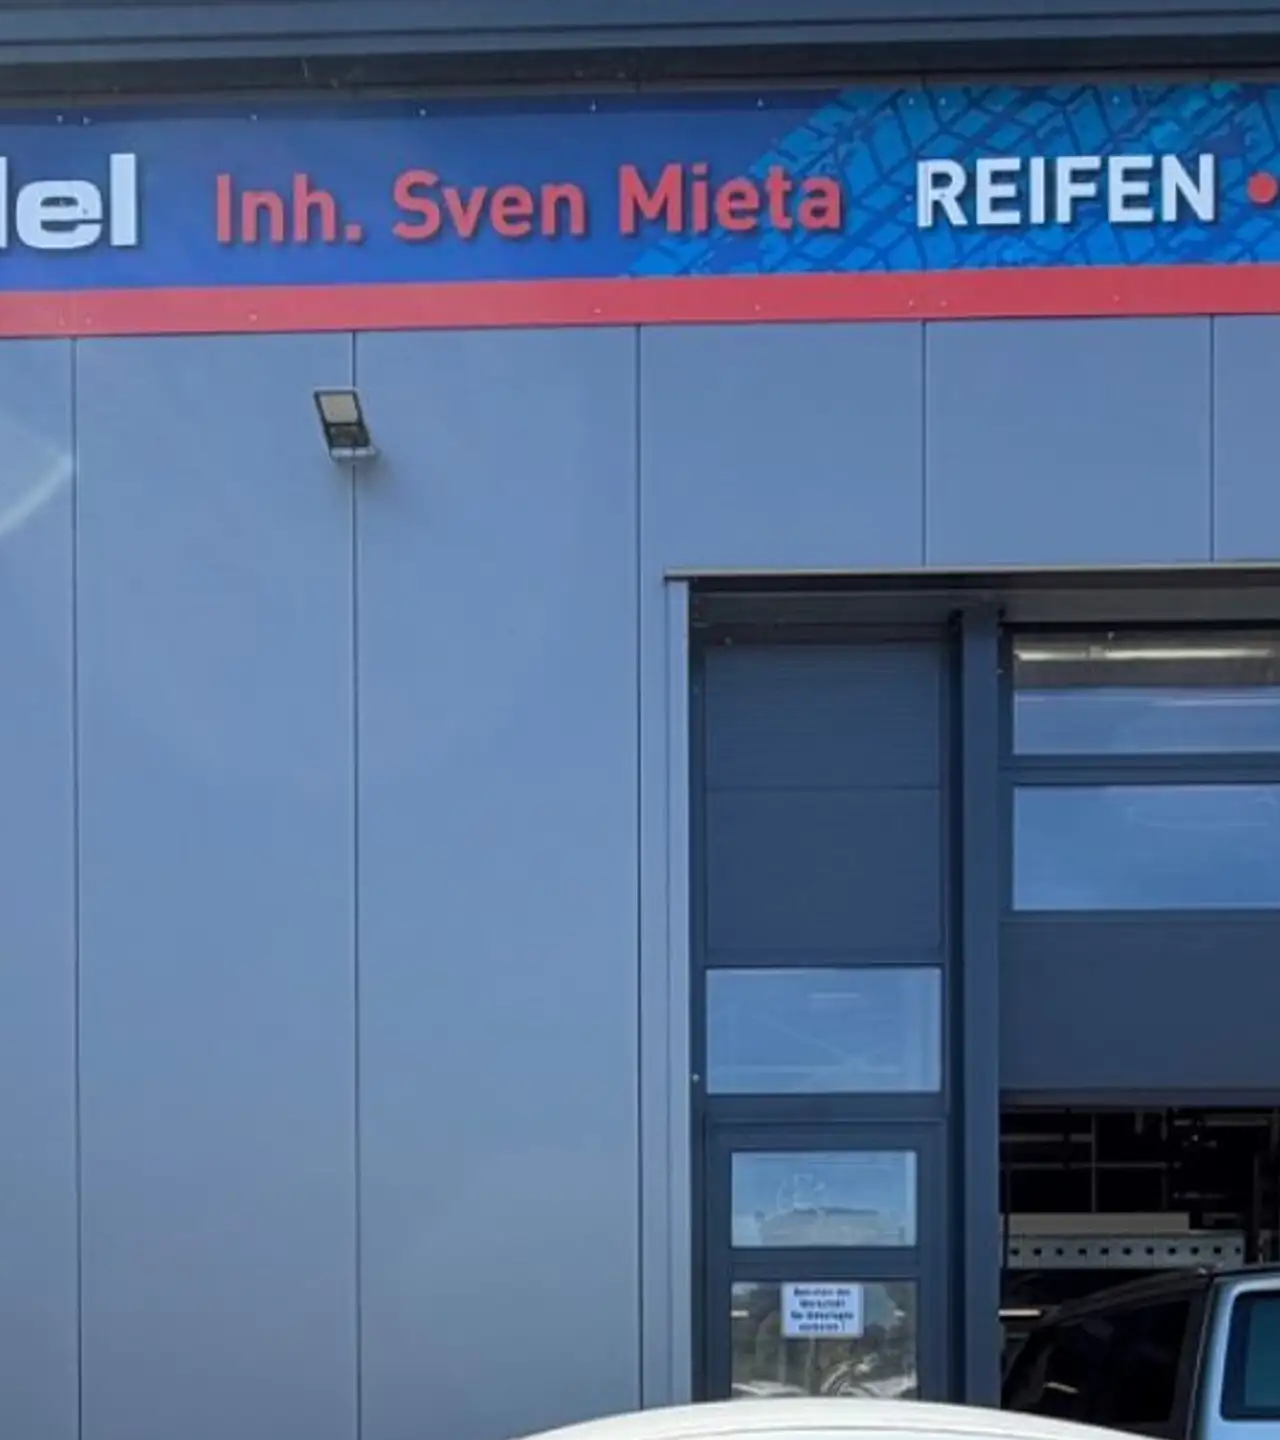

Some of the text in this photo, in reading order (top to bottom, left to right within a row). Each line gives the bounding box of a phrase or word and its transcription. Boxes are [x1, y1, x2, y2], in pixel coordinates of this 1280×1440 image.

[214, 165, 842, 243] Inh. Sven Mieta
[917, 153, 1215, 227] REIFEN
